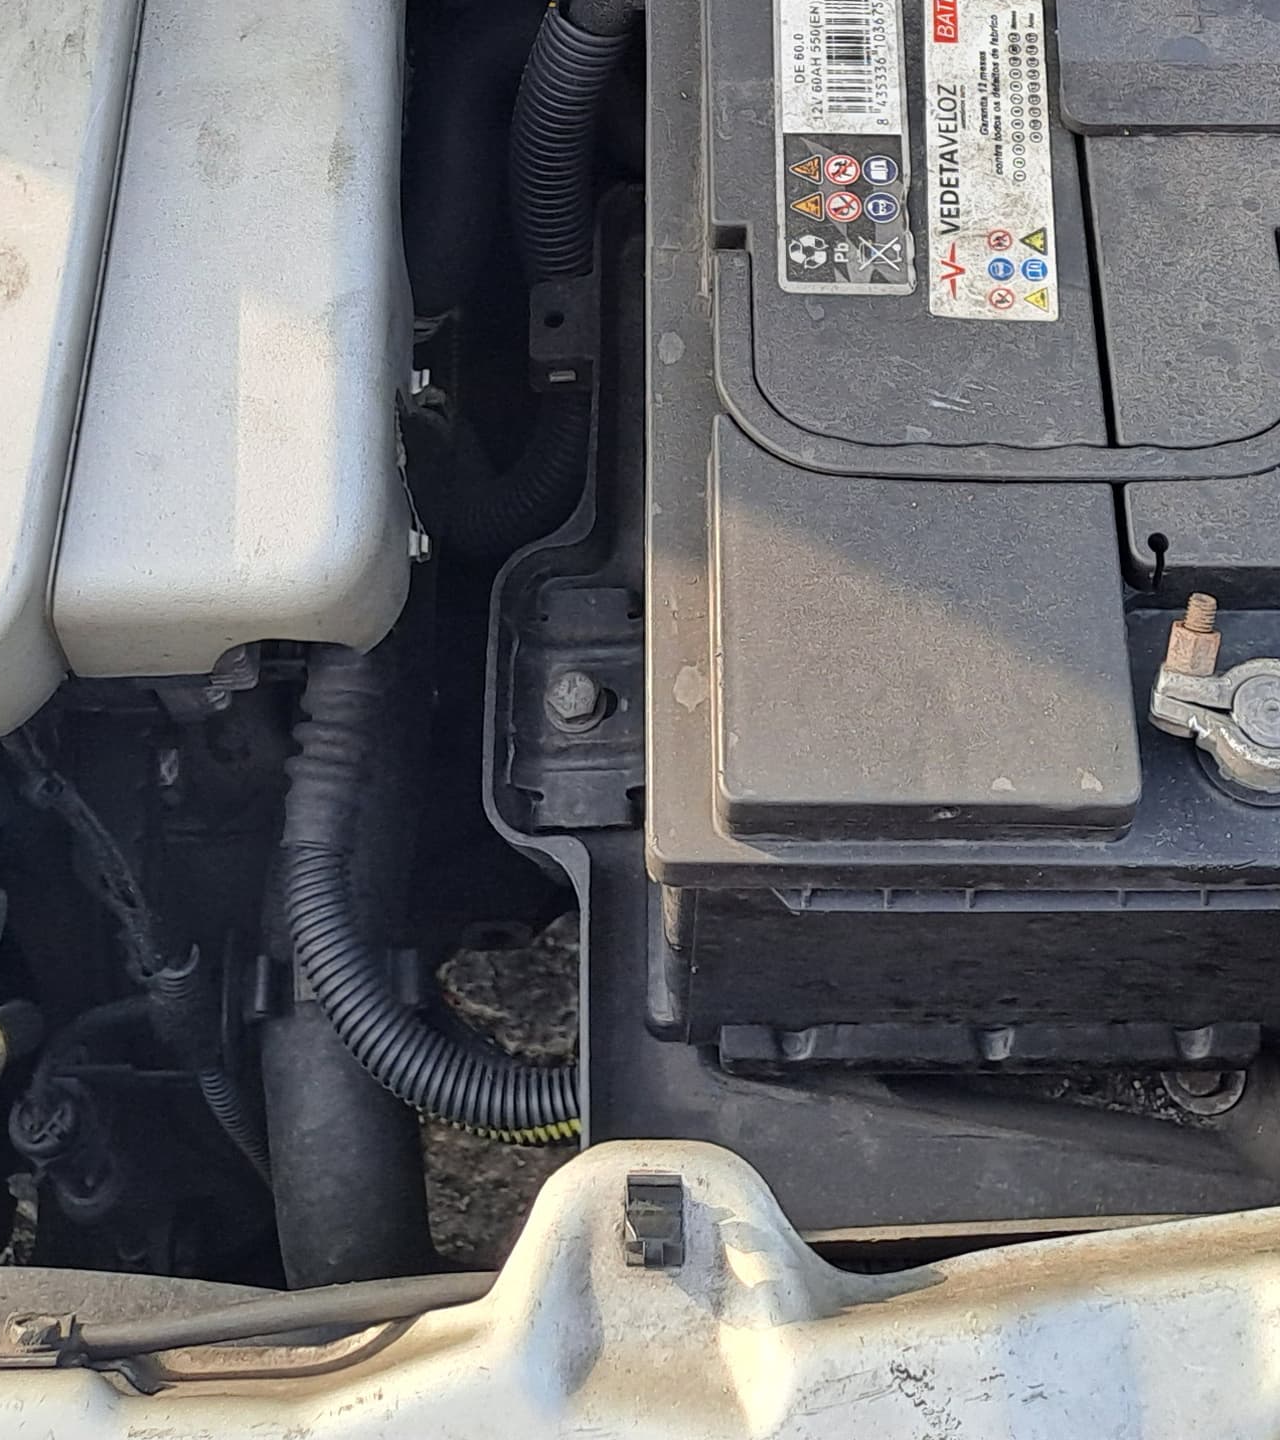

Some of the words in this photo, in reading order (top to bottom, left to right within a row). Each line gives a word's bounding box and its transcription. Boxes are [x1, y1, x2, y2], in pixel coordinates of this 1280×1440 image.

[809, 1, 824, 53] 550(EN)
[872, 1, 886, 49] 103675
[989, 14, 999, 47] fabrico
[793, 33, 805, 61] 60.0
[989, 48, 999, 60] de
[794, 64, 805, 84] DE
[810, 57, 823, 93] 60AH
[874, 57, 888, 107] 435336
[990, 62, 1001, 99] defeitos
[810, 97, 824, 122] 12V
[993, 101, 1001, 112] os
[991, 115, 1002, 142] todos
[937, 84, 960, 237] VEDETAVELOZ
[993, 144, 1003, 175] contra
[834, 242, 849, 263] Pb
